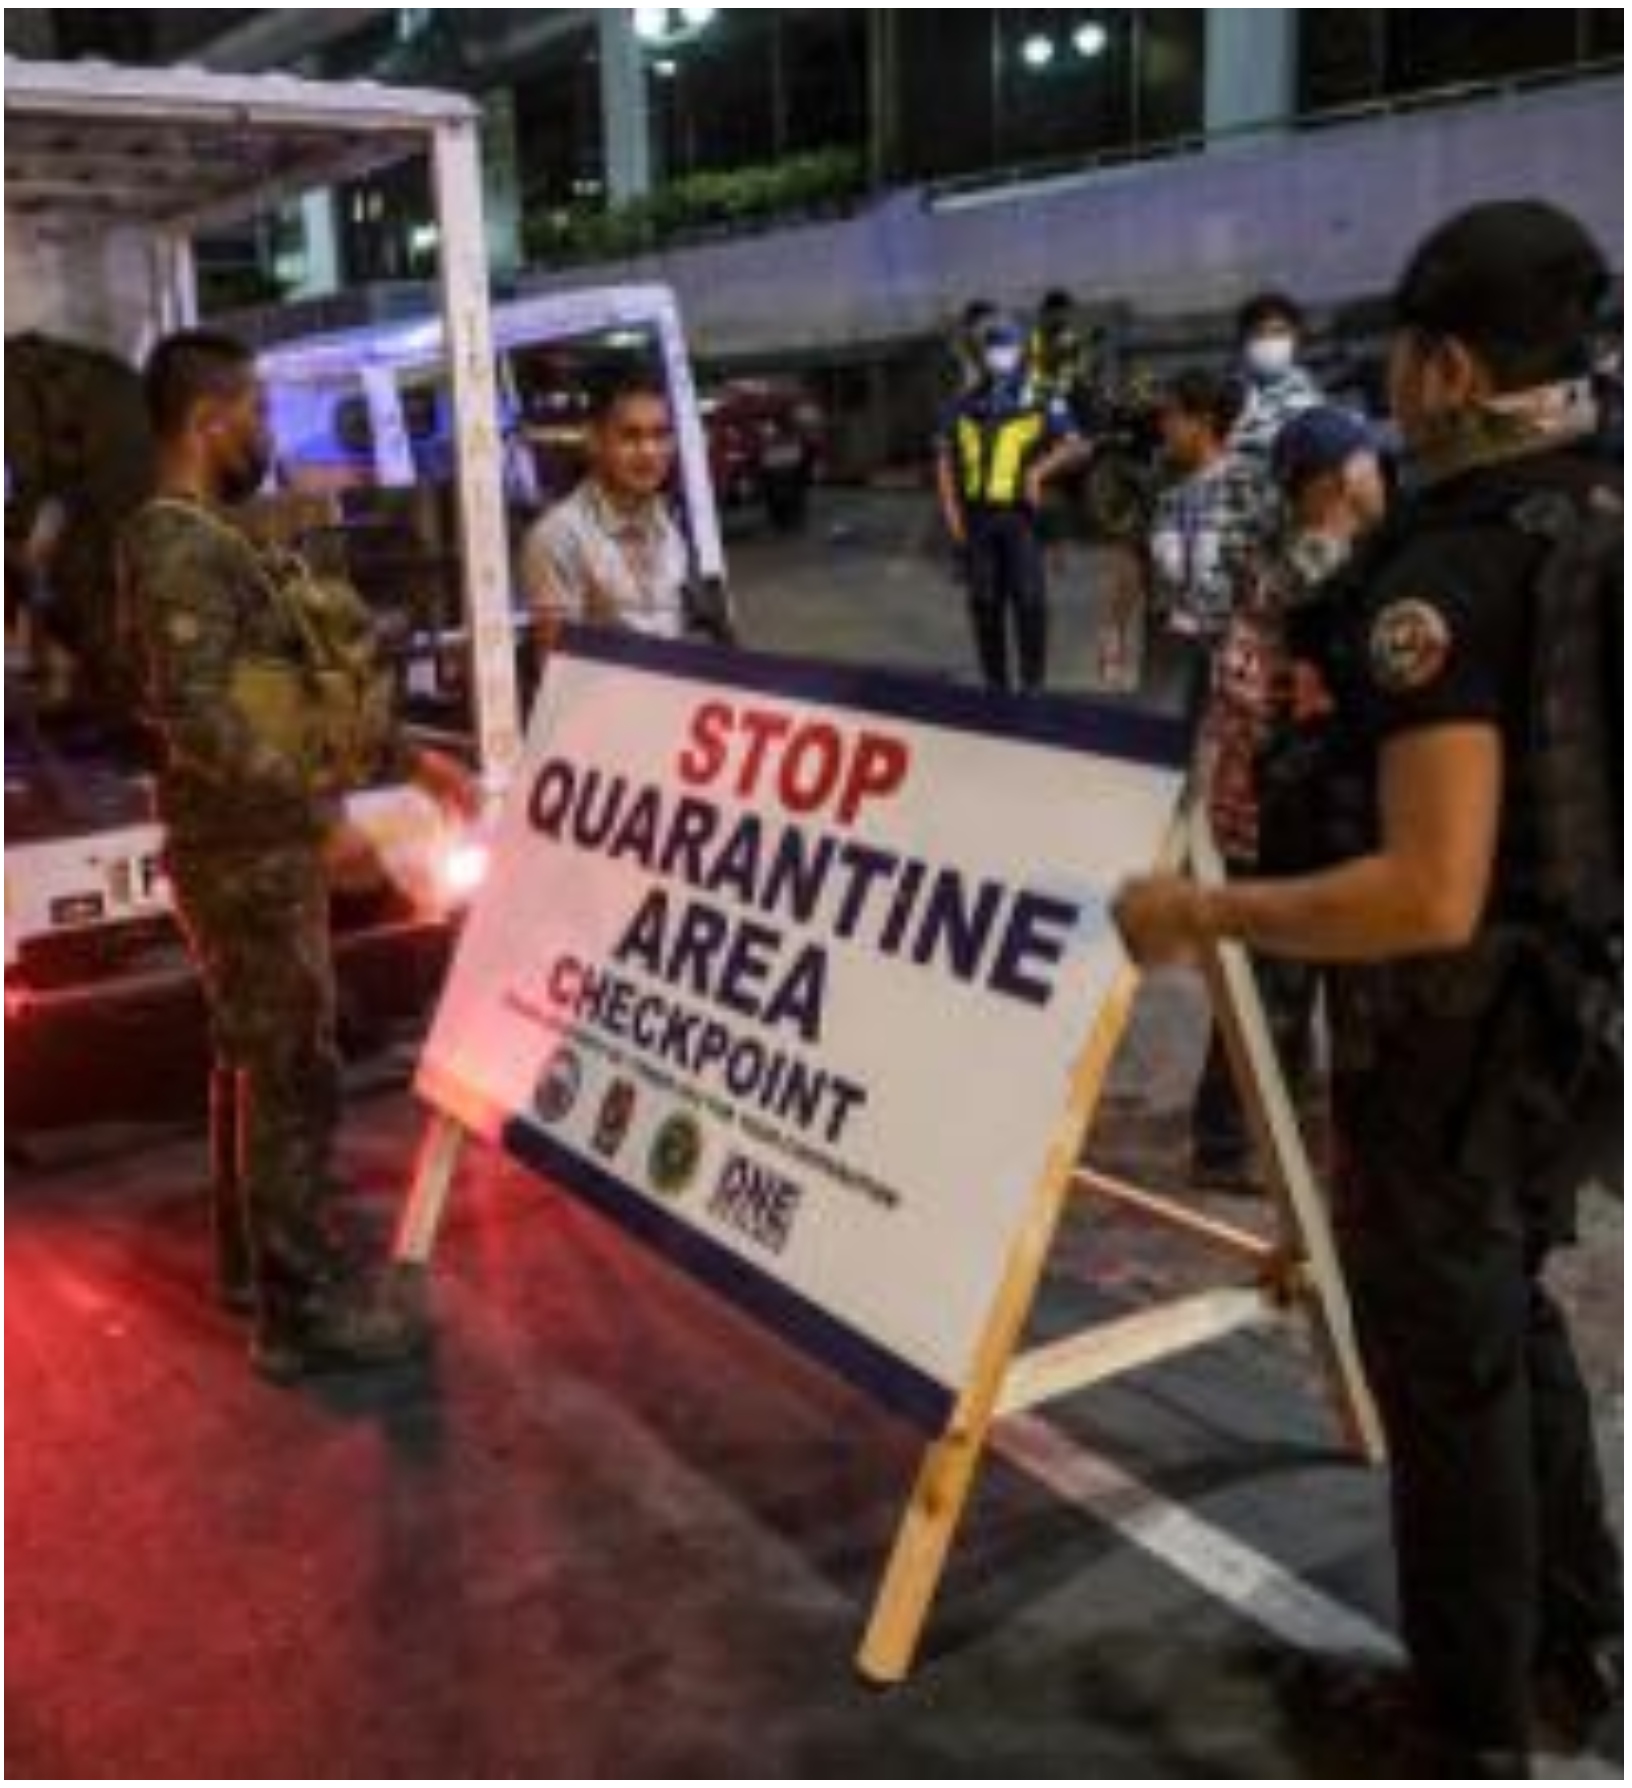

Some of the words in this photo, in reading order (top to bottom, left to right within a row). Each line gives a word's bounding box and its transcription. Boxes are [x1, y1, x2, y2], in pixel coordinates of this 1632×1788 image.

[679, 700, 910, 825] STOP
[525, 759, 1079, 1005] QUARANTINE
[614, 888, 830, 1043] AREA
[548, 954, 867, 1145] CHECKPOINT
[718, 1154, 802, 1219] ONE
